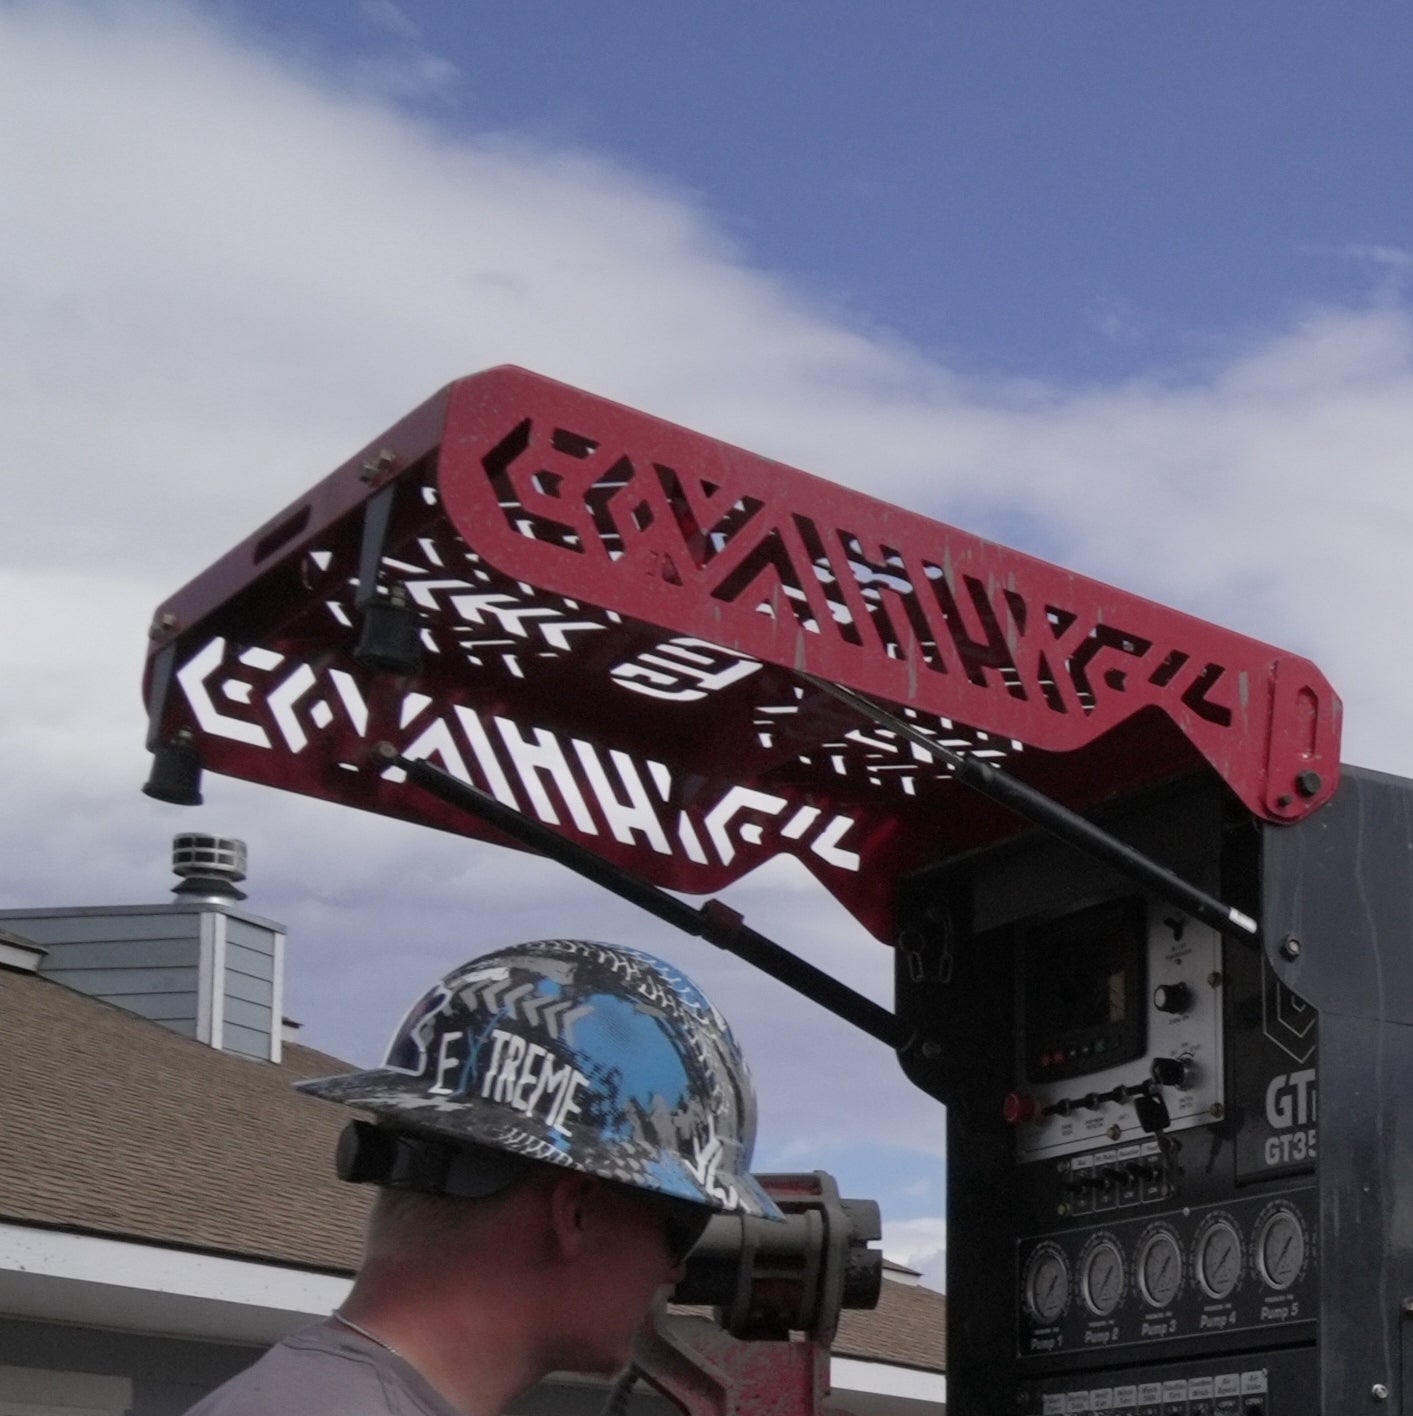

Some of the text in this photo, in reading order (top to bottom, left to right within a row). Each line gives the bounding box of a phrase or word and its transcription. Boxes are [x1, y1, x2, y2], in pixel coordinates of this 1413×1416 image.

[1290, 1302, 1299, 1317] 5
[1228, 1310, 1237, 1325] 4
[1168, 1319, 1177, 1334] 3
